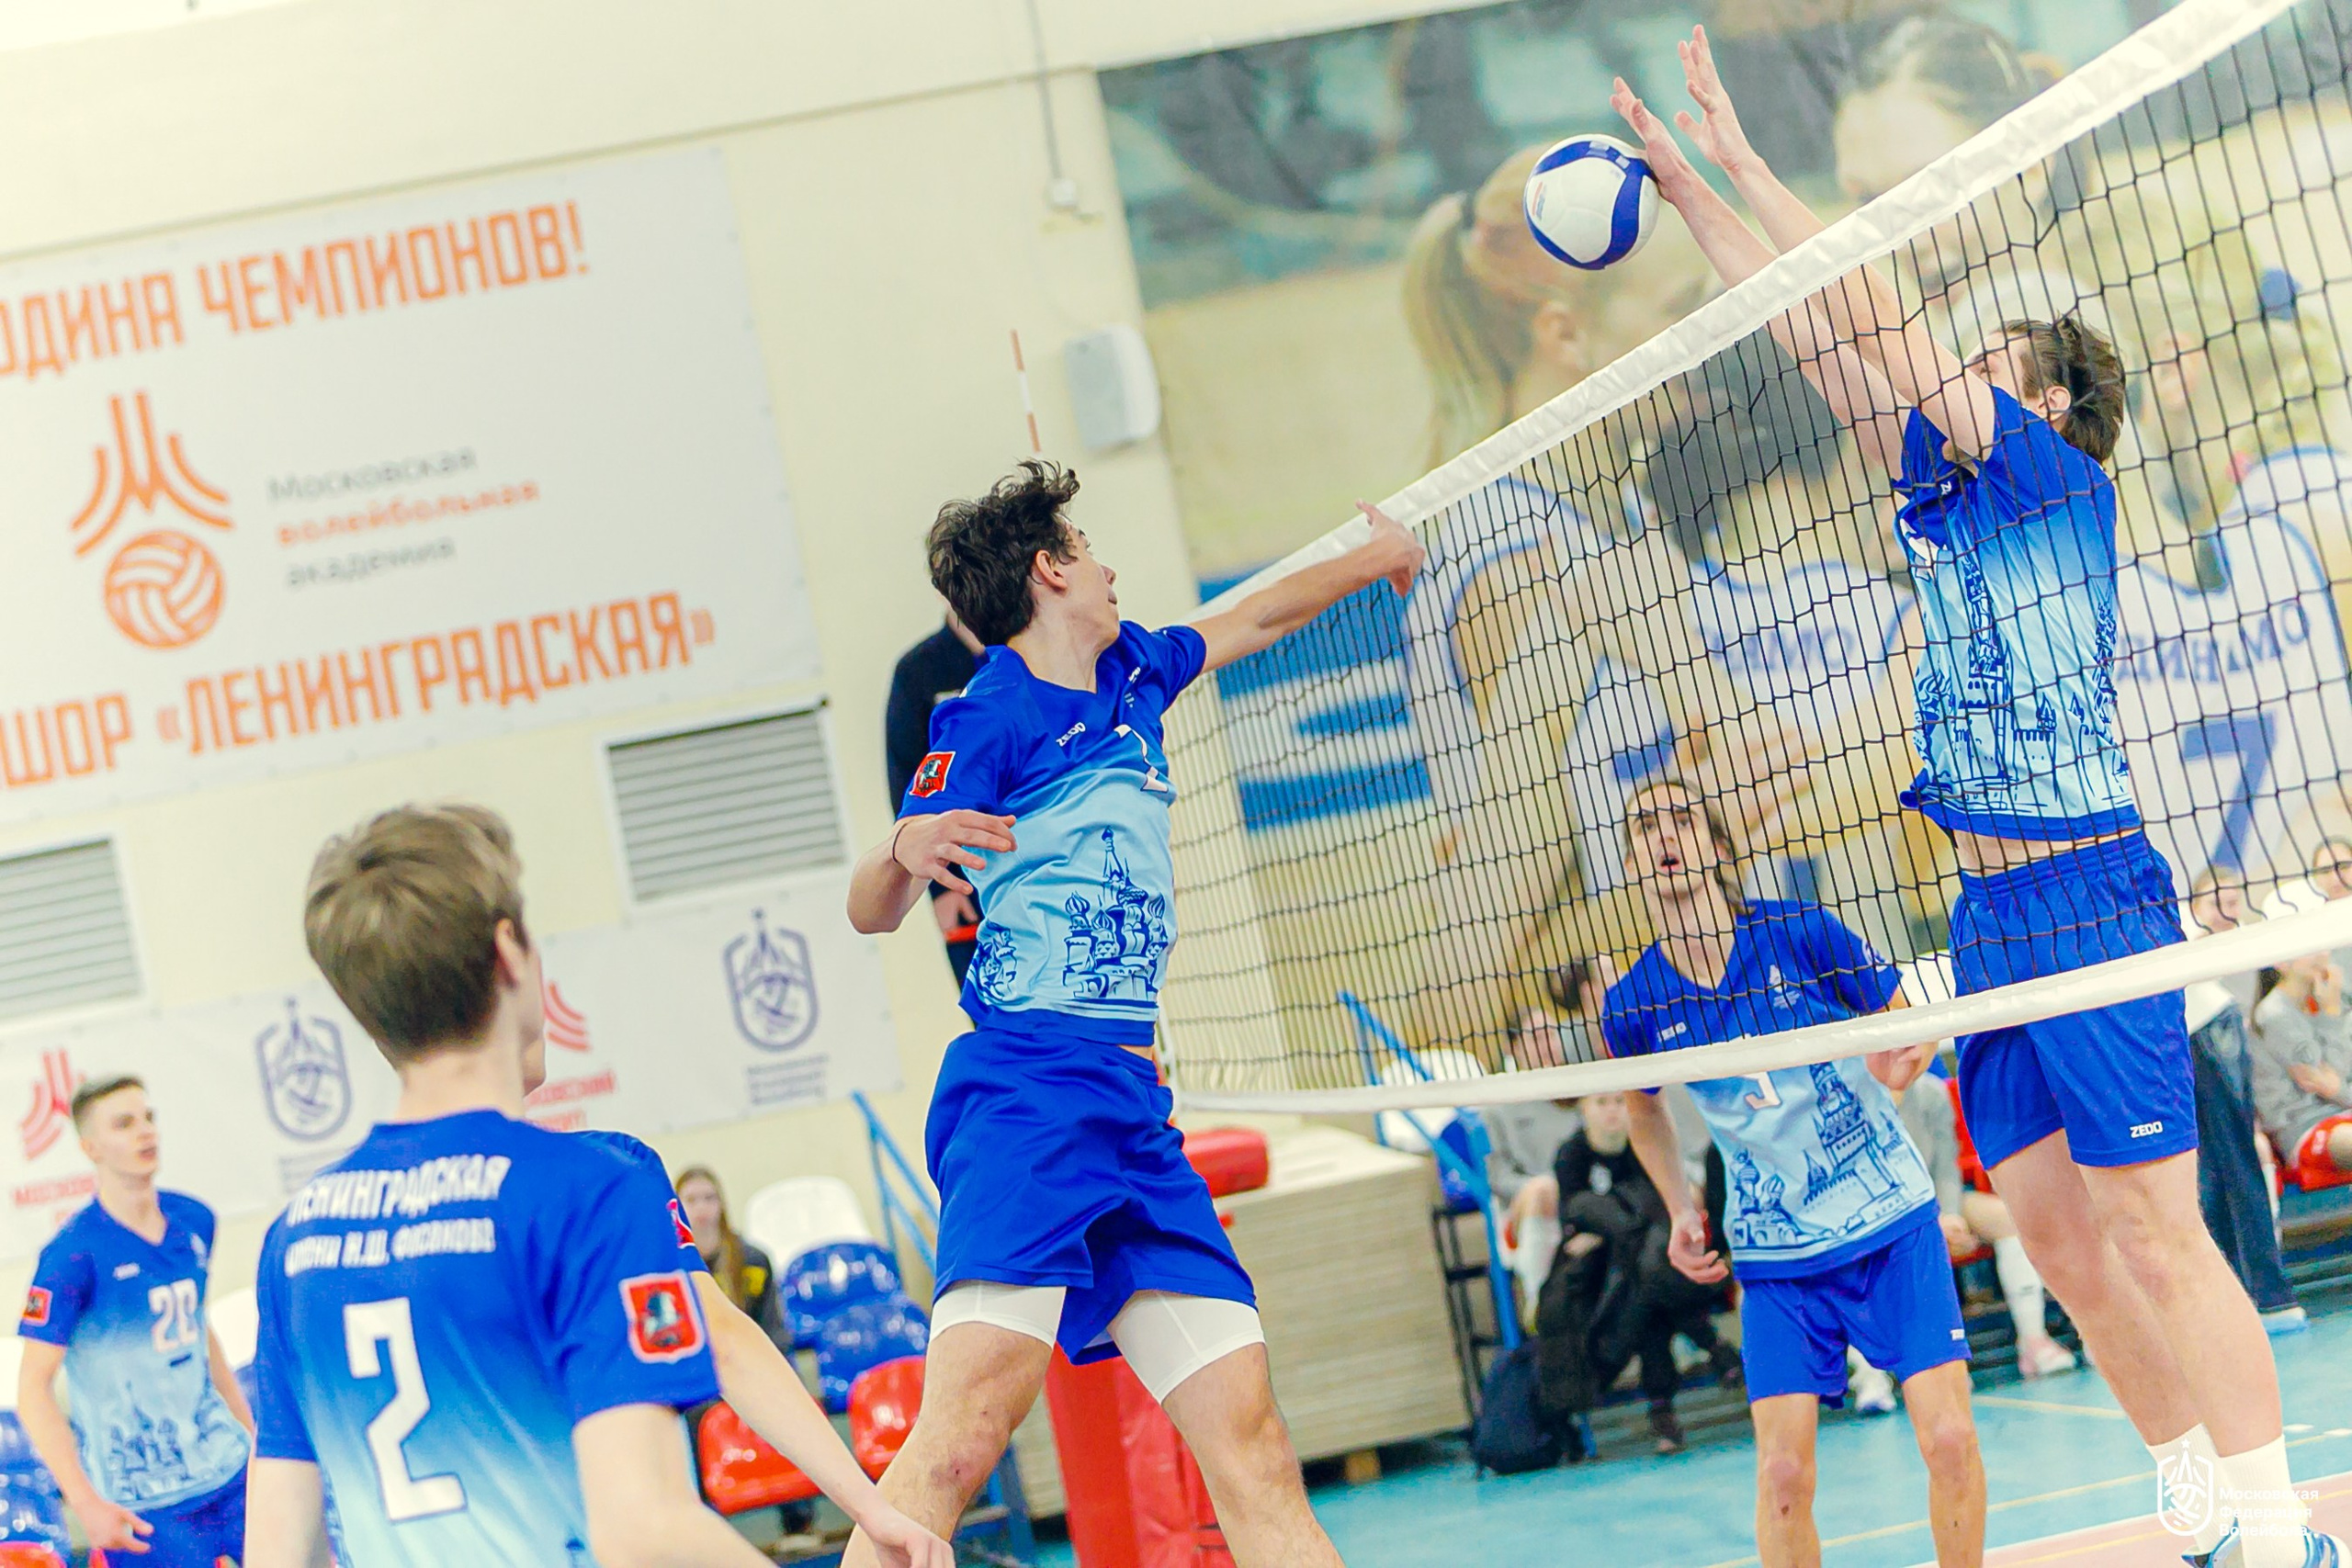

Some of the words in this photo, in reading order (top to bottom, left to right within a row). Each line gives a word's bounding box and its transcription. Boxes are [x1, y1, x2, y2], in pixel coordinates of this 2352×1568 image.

[196, 201, 589, 333] ЧЕМПИОНОВ!
[267, 446, 477, 502] Московская
[276, 480, 540, 546] волейбольная
[284, 536, 456, 590] академия
[156, 590, 715, 755] «ЛЕНИНГРАДСКАЯ»
[1056, 722, 1086, 747] ZEDO
[2183, 712, 2277, 874] 7
[2130, 1121, 2164, 1139] ZEDO
[343, 1296, 468, 1521] 2
